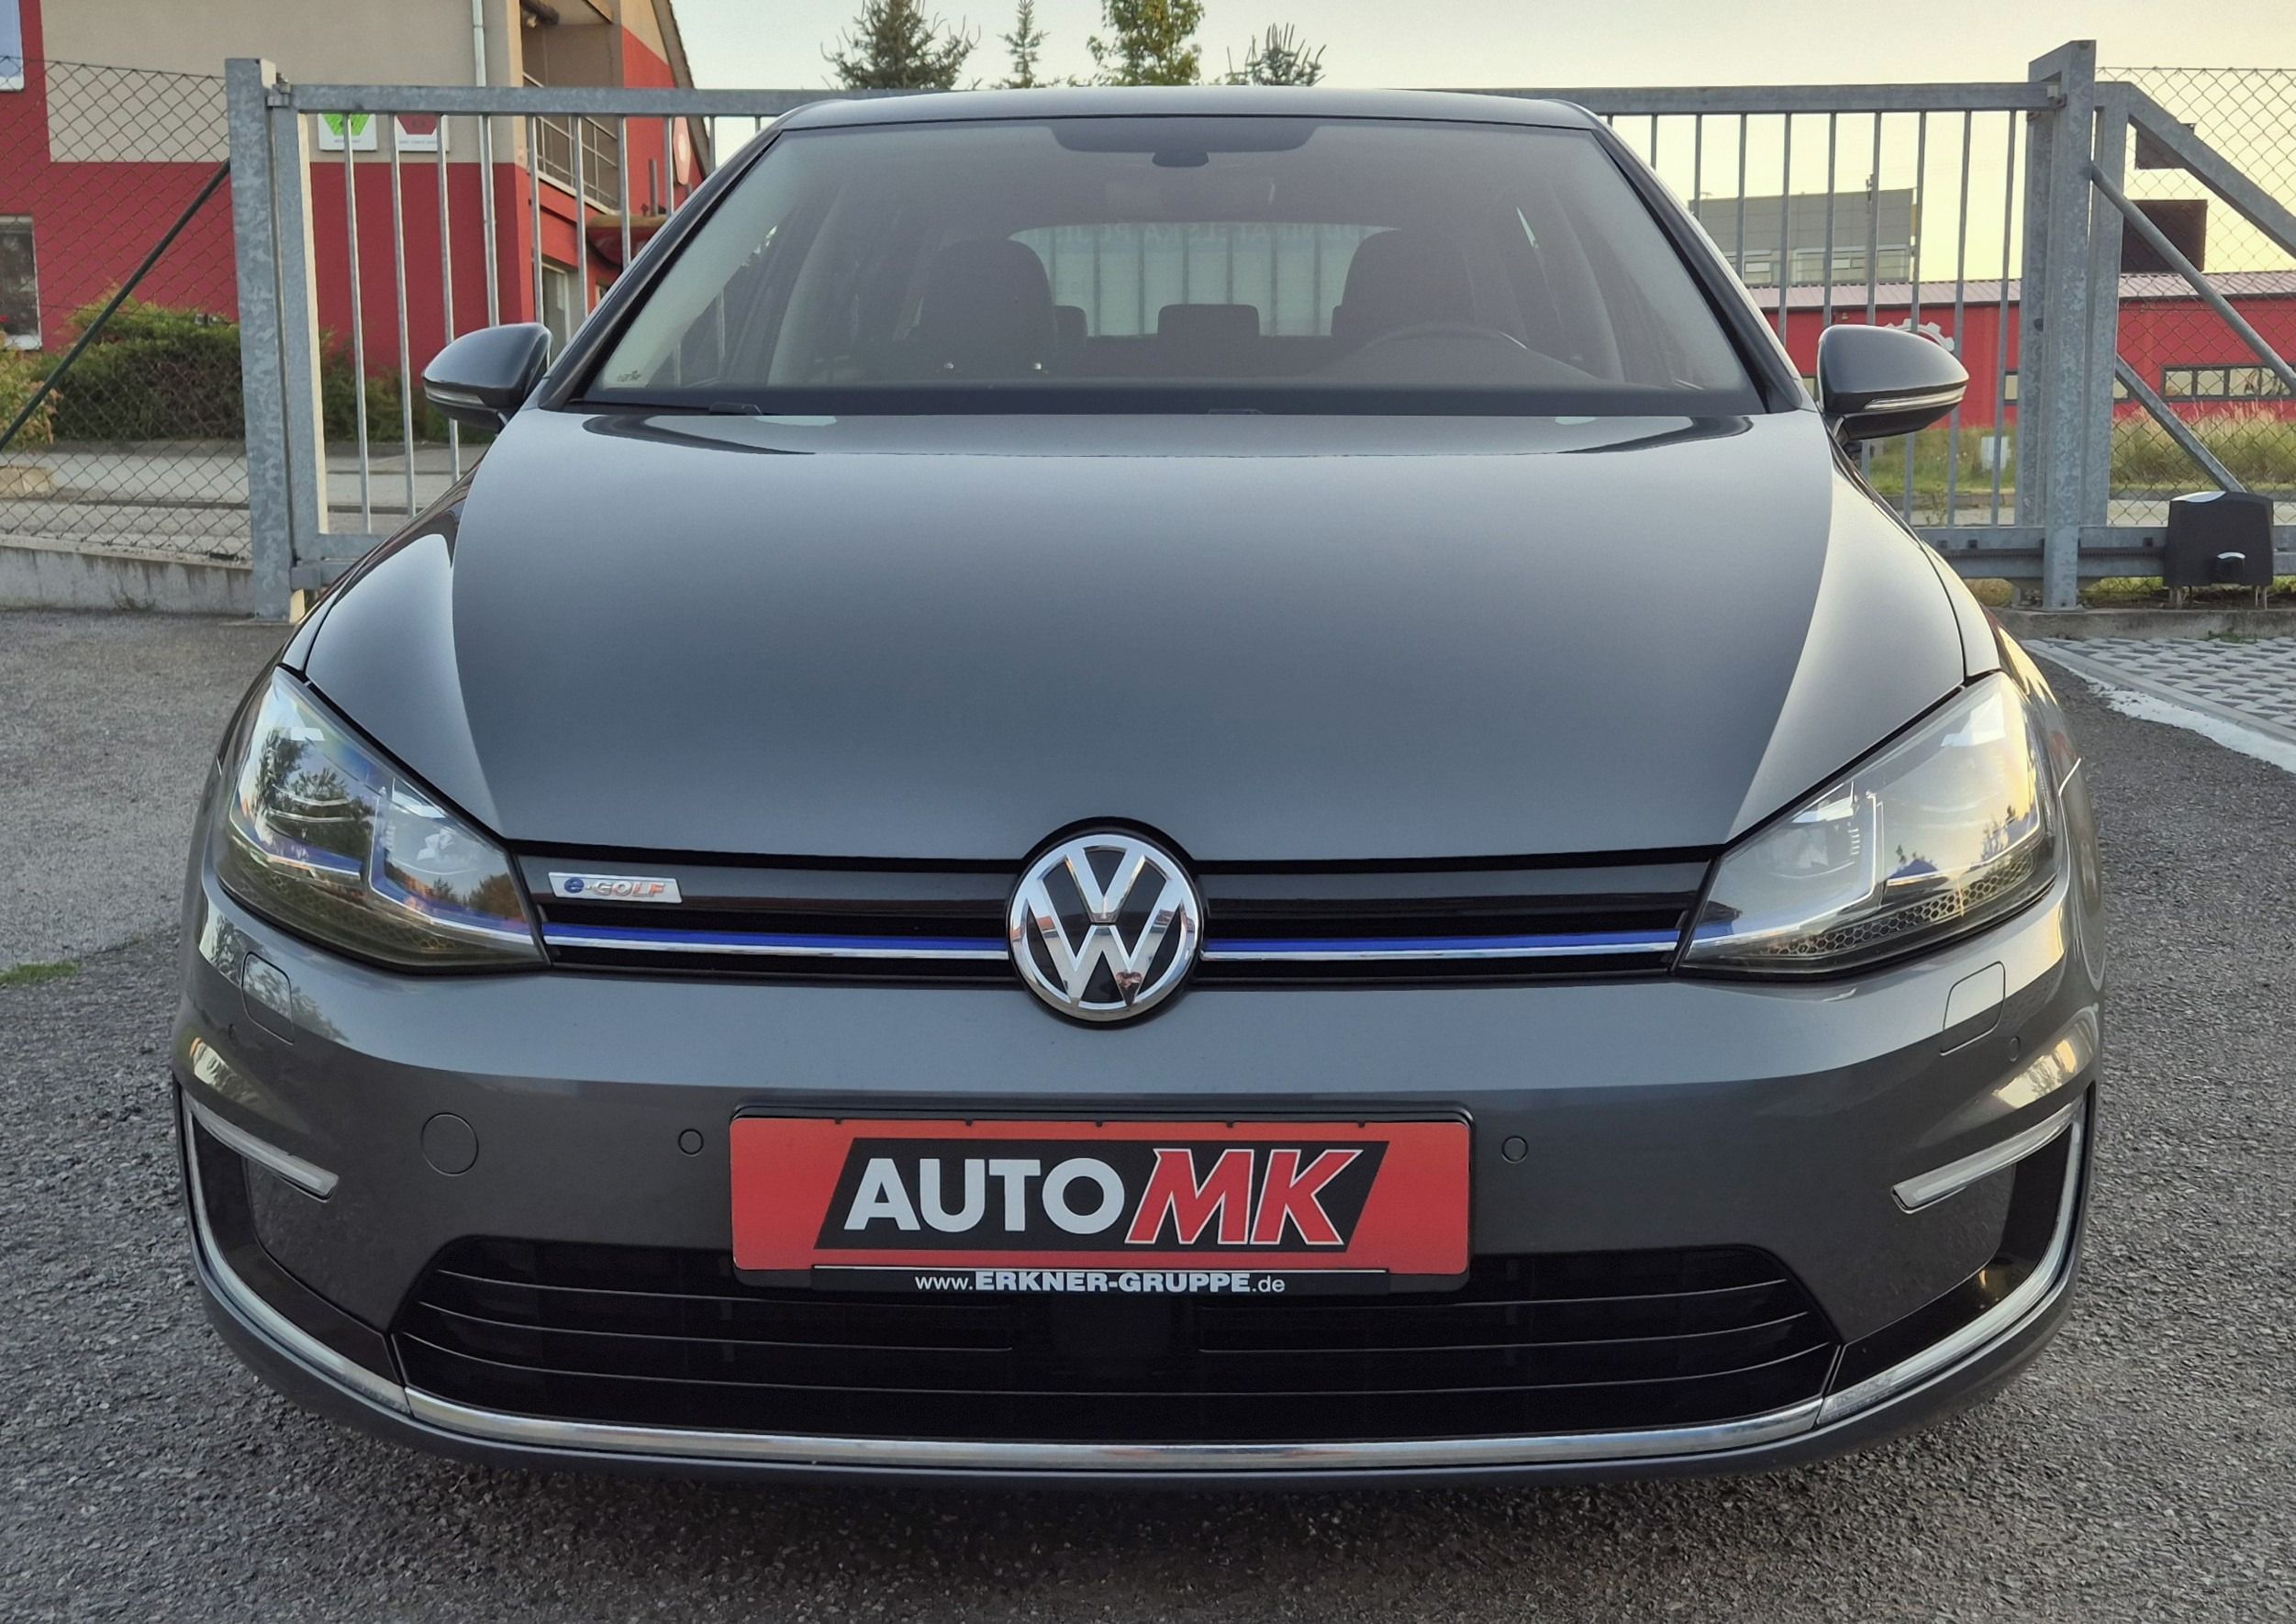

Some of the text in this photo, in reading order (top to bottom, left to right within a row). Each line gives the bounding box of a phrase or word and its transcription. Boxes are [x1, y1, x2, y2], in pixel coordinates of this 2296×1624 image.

[563, 876, 666, 897] e-GOLF
[1015, 839, 1193, 1015] VW
[914, 1271, 1286, 1294] www.ERKNER-GRUPPE.de
